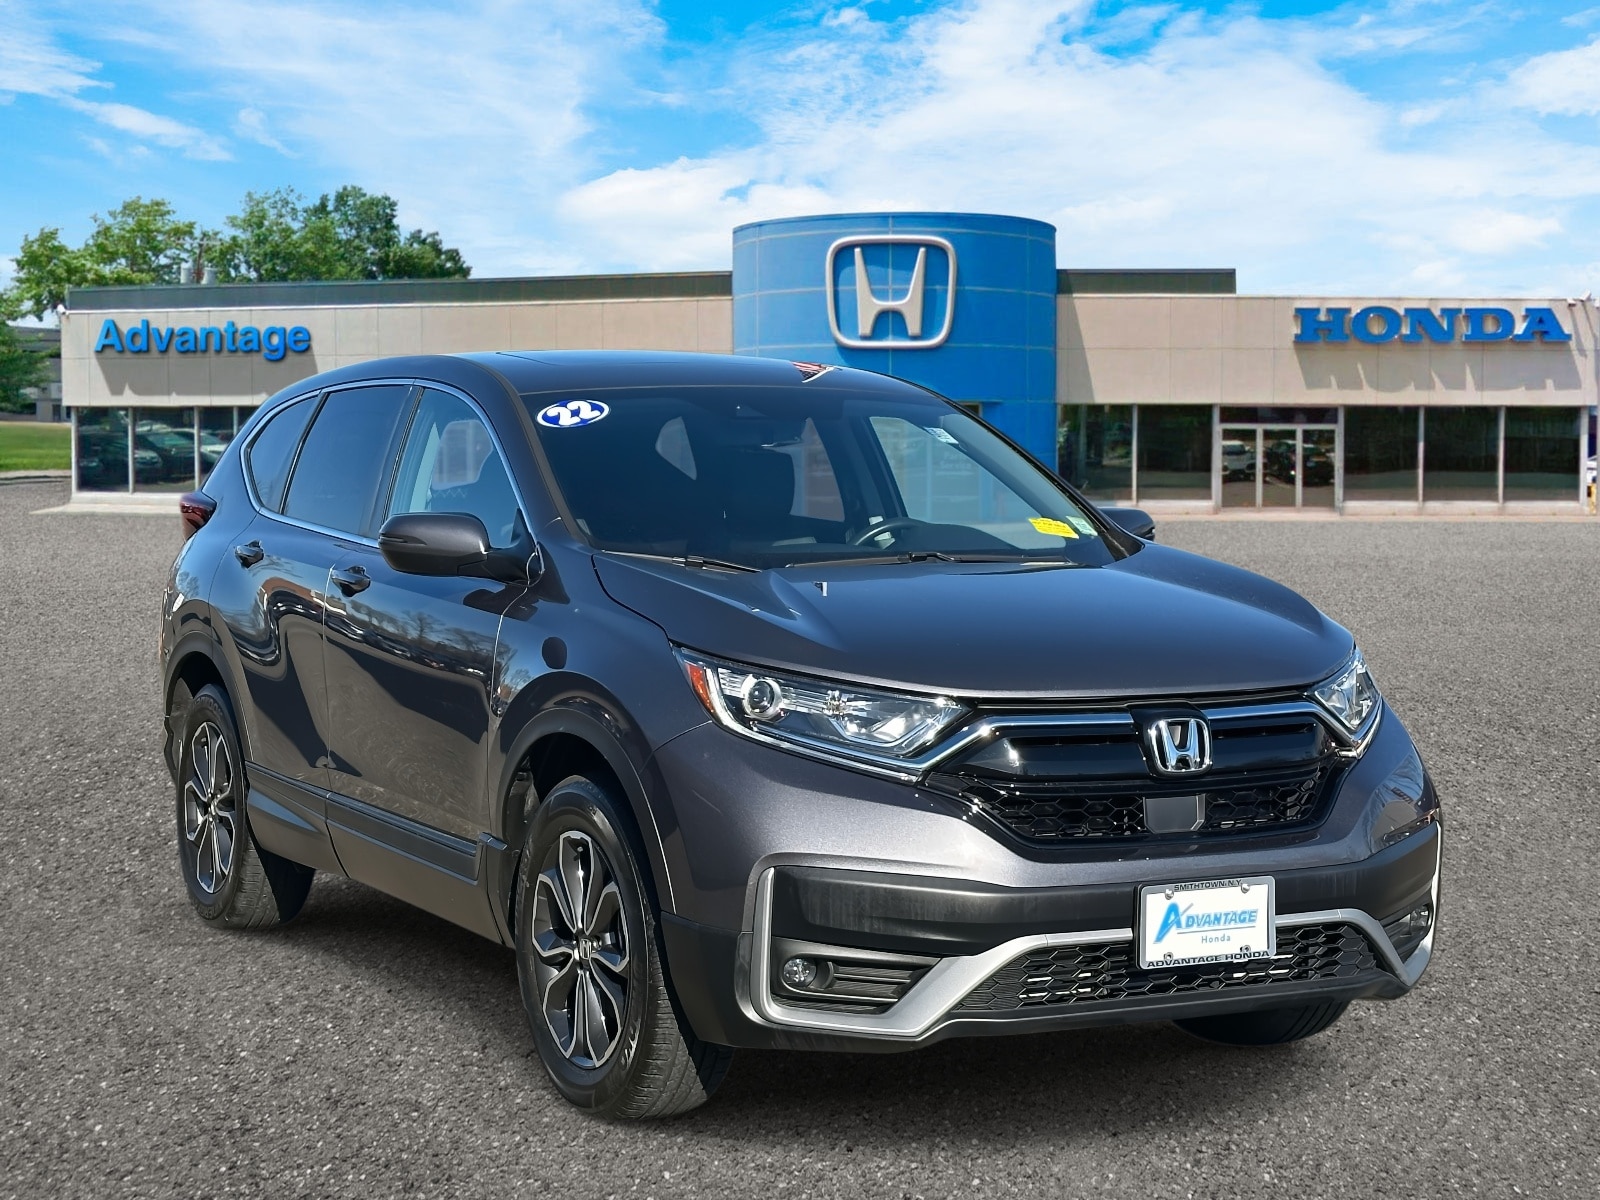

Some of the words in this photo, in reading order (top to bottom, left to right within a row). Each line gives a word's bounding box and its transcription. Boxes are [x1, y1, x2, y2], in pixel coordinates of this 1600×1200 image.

[1293, 306, 1572, 342] HONDA
[95, 319, 311, 361] Advantage
[546, 400, 601, 426] 22
[1153, 902, 1258, 944] ADVANTAGE
[1201, 934, 1231, 944] Honda
[1147, 956, 1221, 967] ADVANTAGE
[1225, 951, 1270, 960] HONDA
